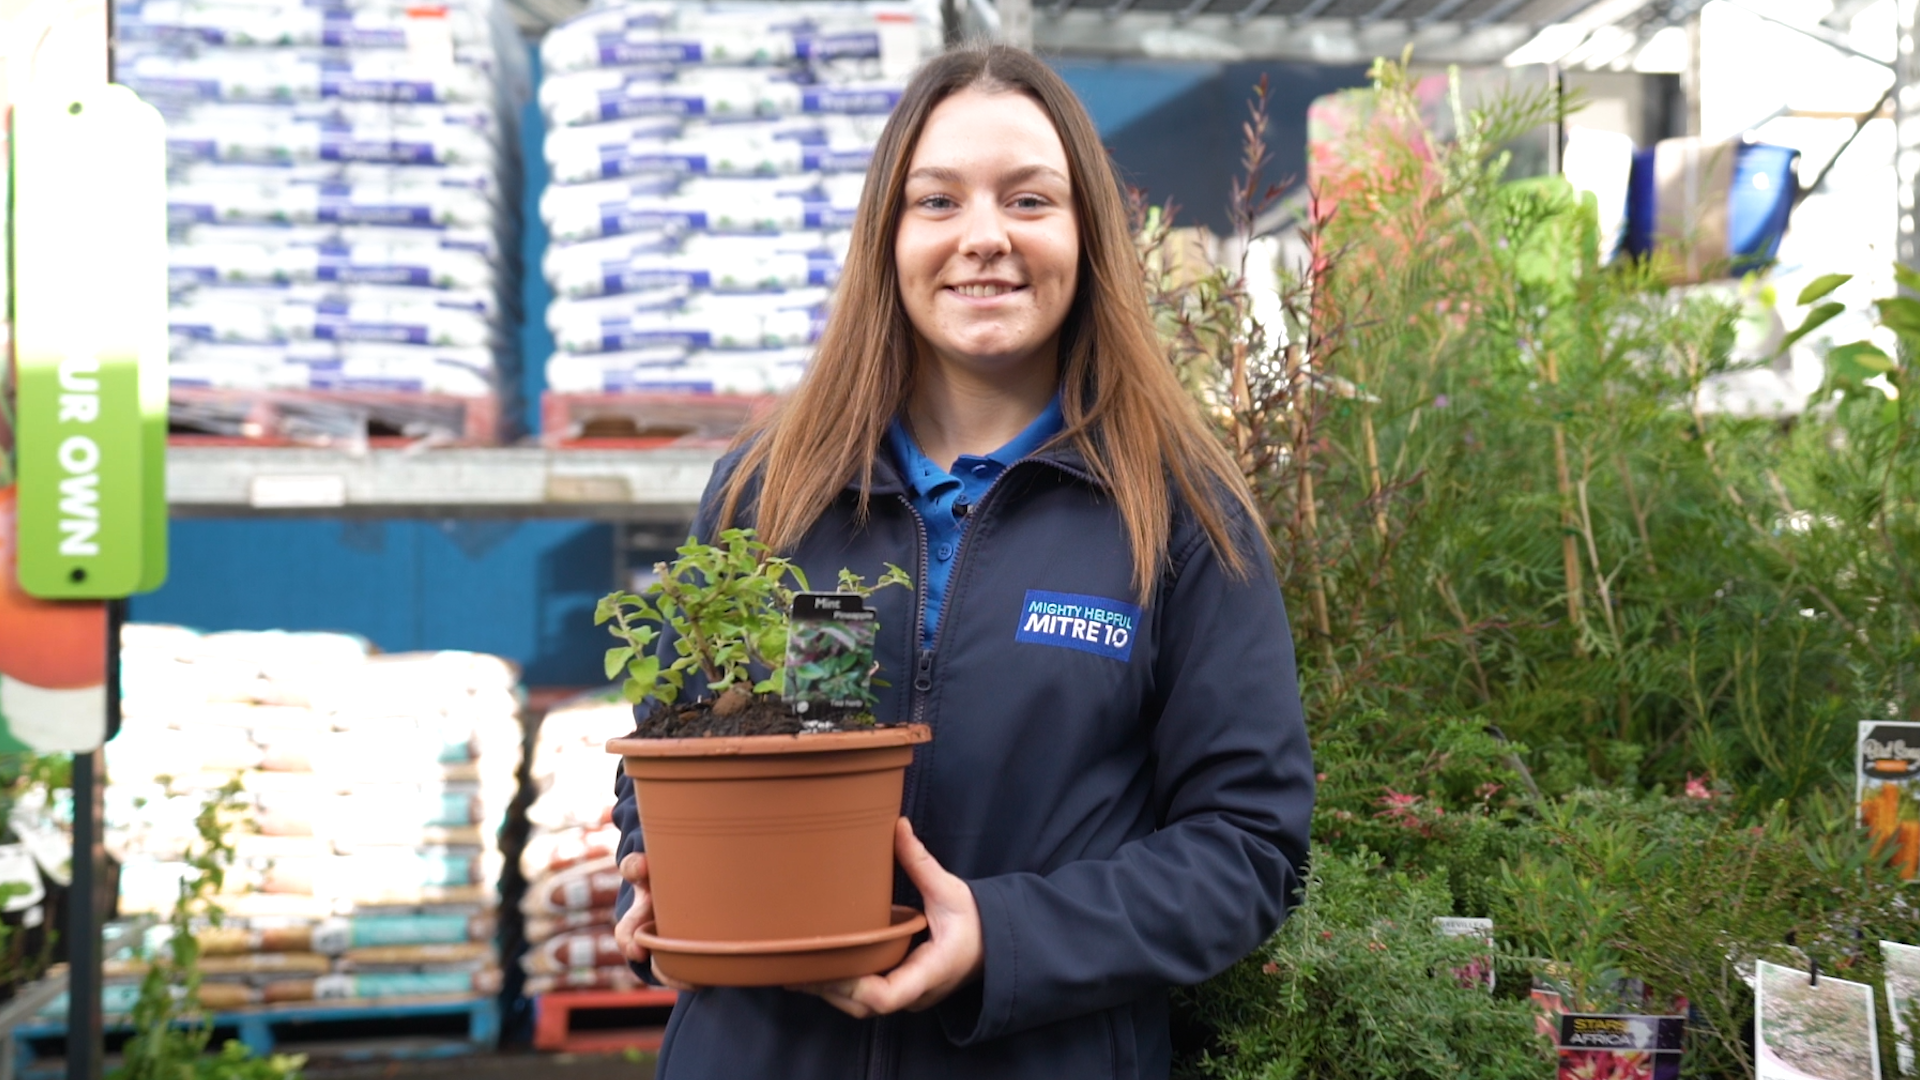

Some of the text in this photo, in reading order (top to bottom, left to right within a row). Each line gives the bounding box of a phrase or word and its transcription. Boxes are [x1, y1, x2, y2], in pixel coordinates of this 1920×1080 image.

[58, 435, 99, 556] OWN
[814, 598, 841, 609] Mint
[1028, 601, 1132, 630] MIGHTY HELPFUL
[1024, 613, 1128, 648] MITRE 10
[1573, 1018, 1628, 1030] STARS
[1569, 1033, 1632, 1046] AFRICA
